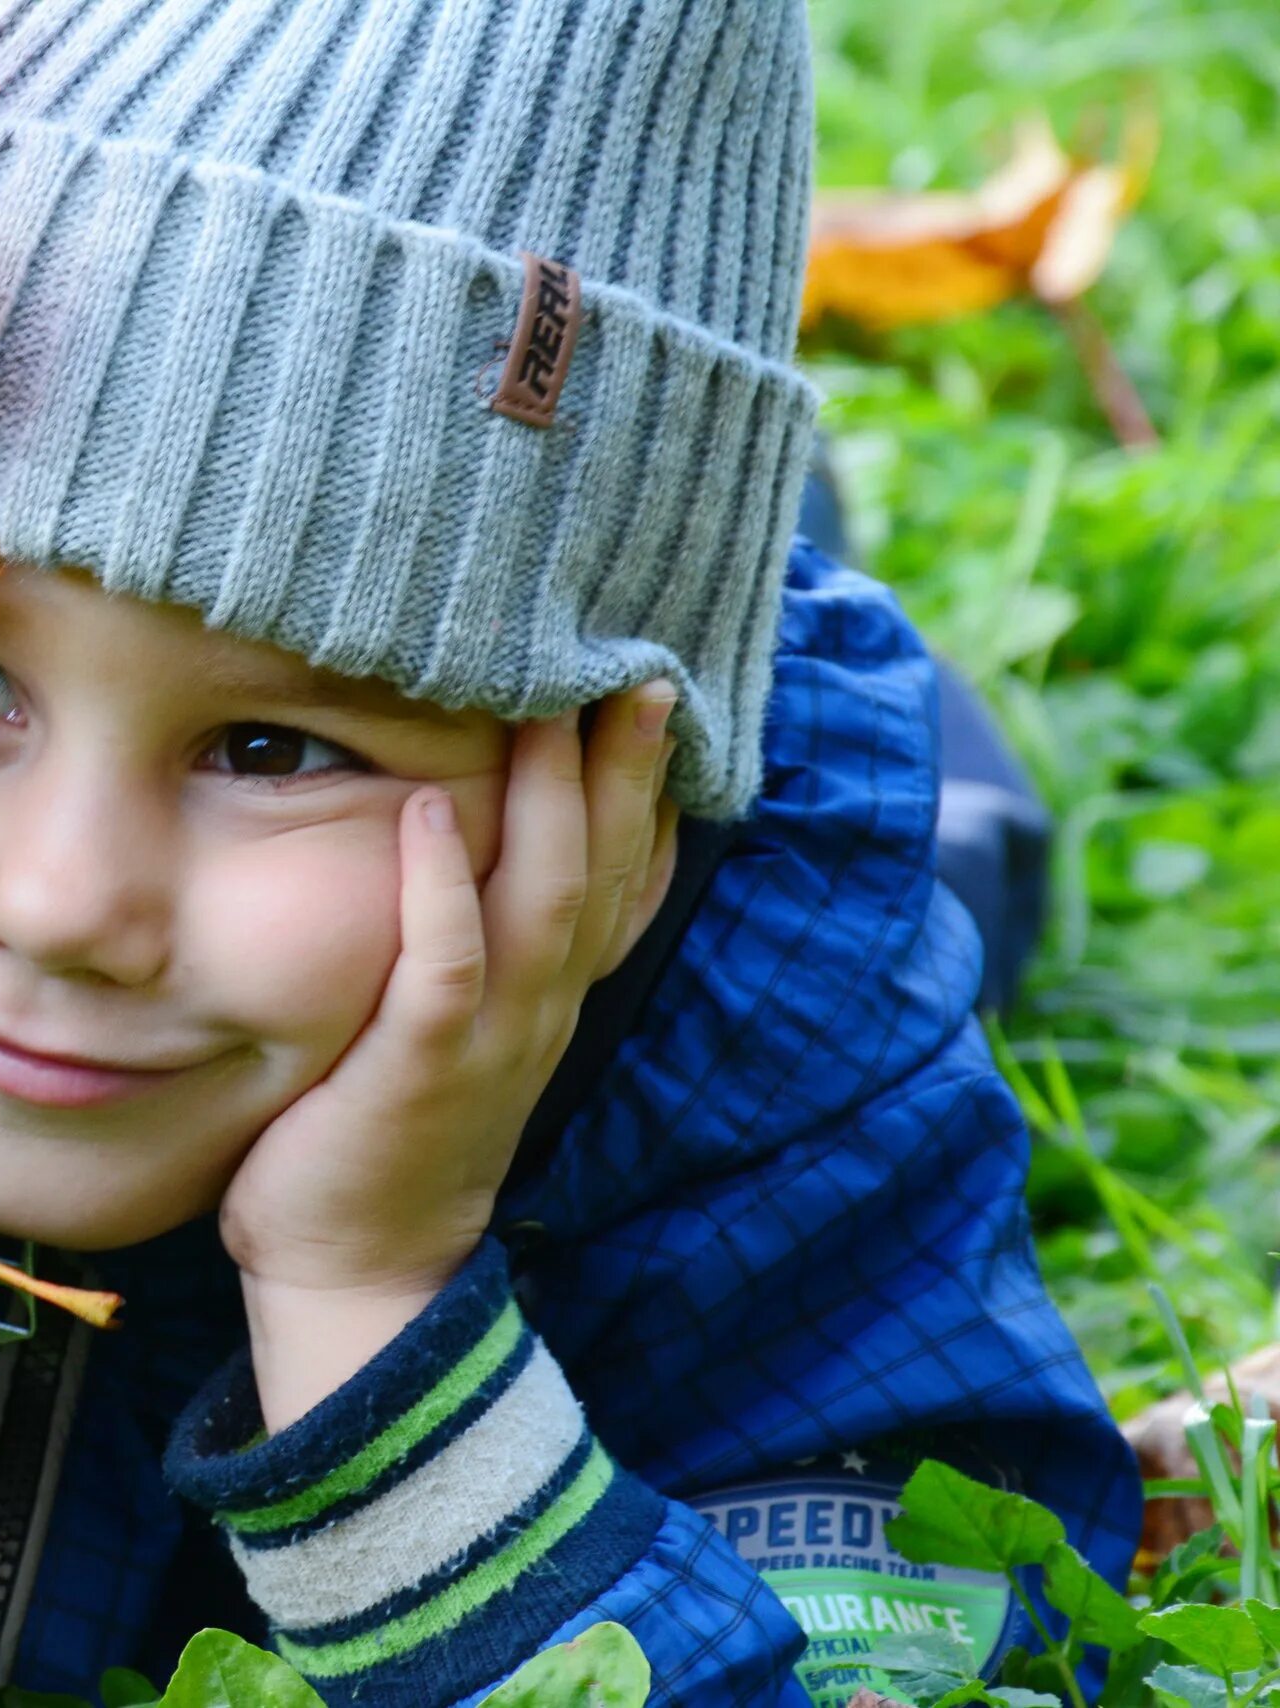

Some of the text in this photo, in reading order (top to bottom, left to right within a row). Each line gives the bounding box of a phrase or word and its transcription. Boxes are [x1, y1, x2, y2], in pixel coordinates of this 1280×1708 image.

[699, 1500, 908, 1553] PEED
[812, 1553, 881, 1573] RACING
[887, 1561, 935, 1581] TEAM
[780, 1593, 975, 1644] DURANCE
[798, 1637, 871, 1661] FFICIAL
[805, 1667, 871, 1691] SPORT
